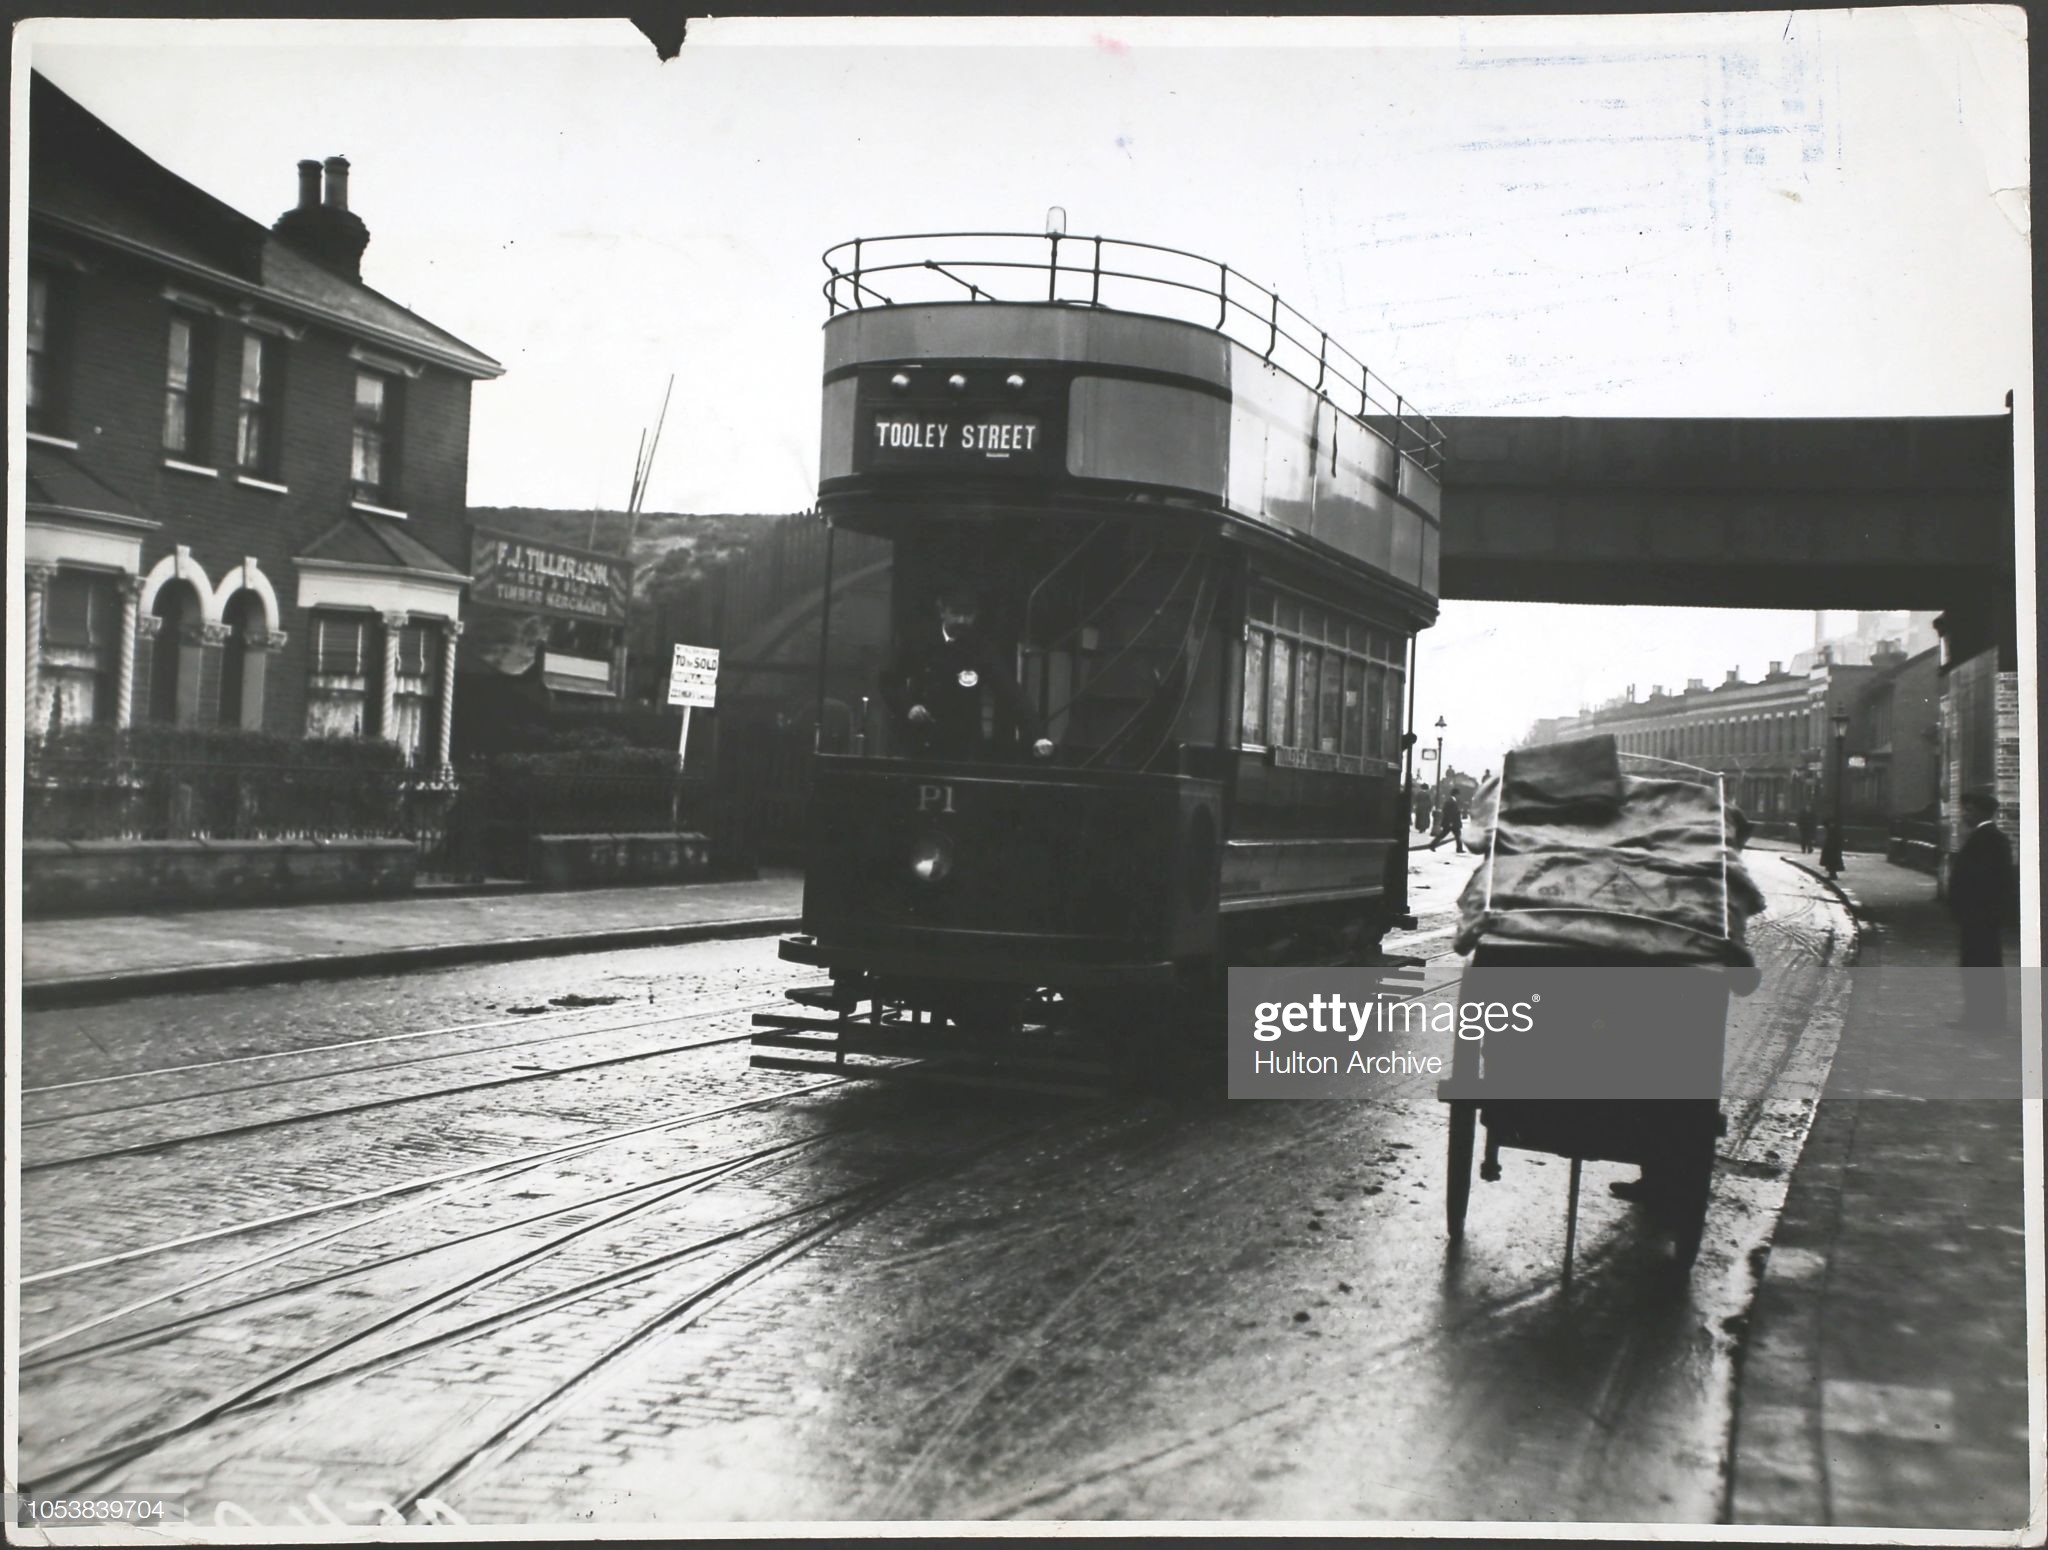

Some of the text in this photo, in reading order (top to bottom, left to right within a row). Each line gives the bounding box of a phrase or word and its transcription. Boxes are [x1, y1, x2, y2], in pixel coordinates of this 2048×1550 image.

[876, 422, 1036, 450] TOOLEY STREET
[497, 583, 543, 603] TIMBER
[675, 654, 686, 667] TO
[694, 656, 718, 671] SOLD
